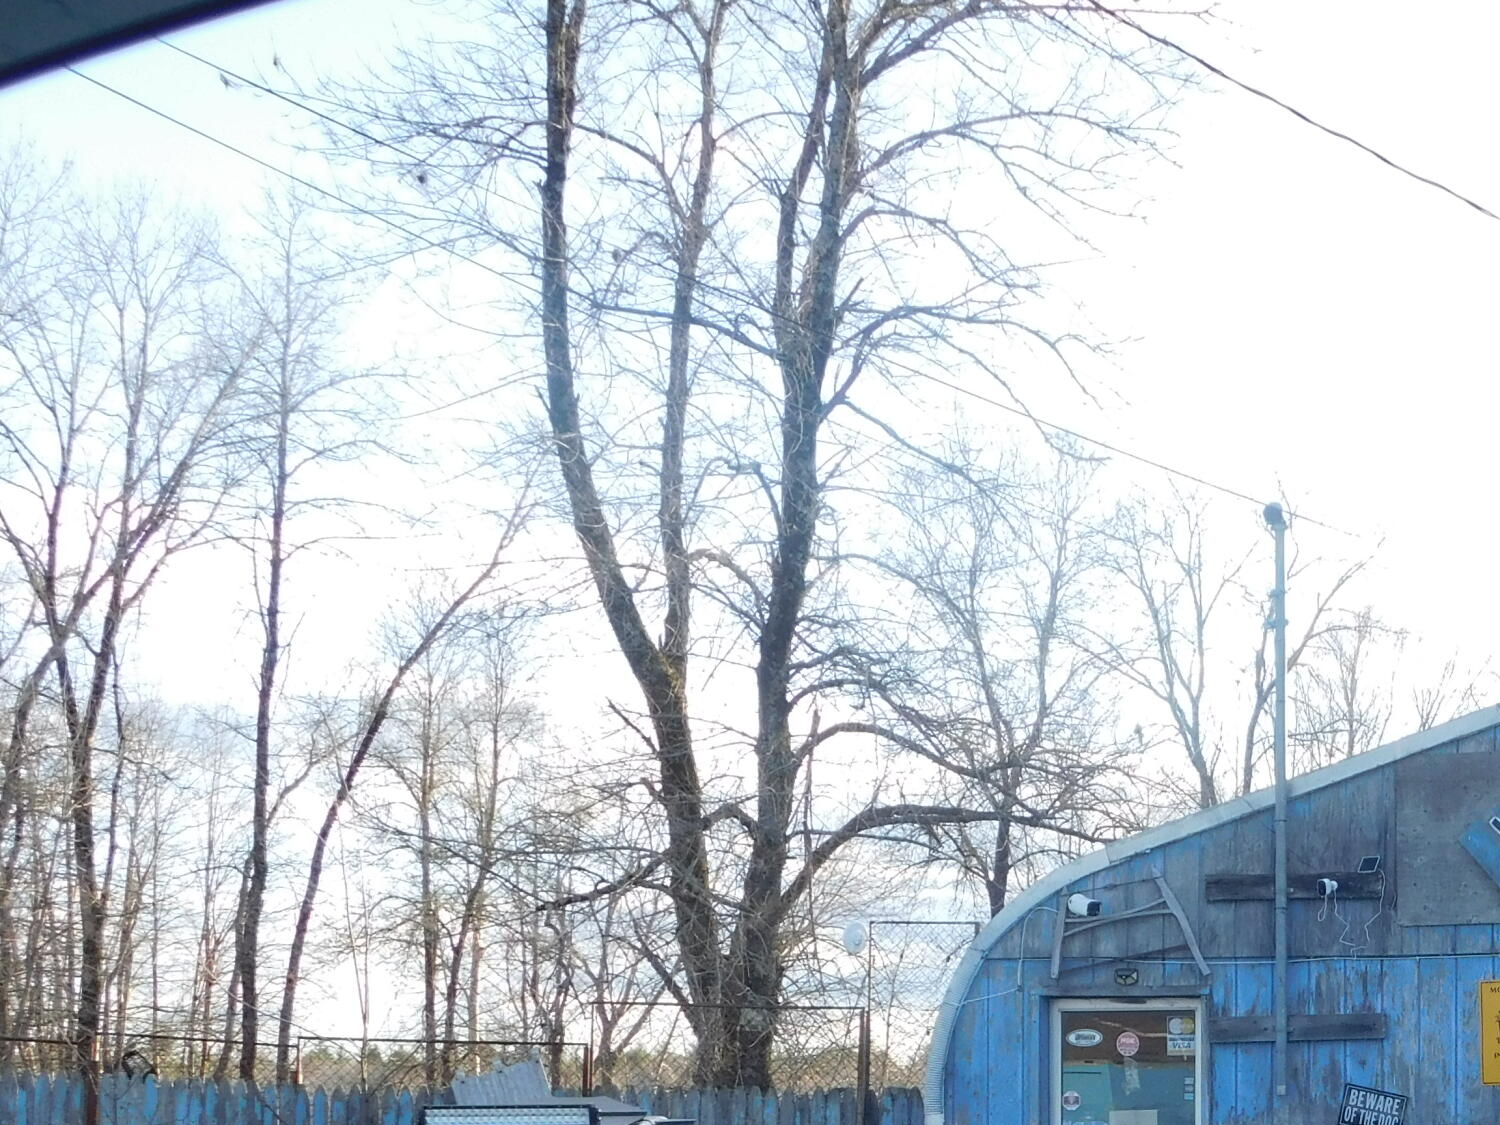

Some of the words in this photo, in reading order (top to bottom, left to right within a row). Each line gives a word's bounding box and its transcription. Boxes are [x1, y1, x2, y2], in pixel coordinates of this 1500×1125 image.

[1171, 1041, 1192, 1050] VISA
[1349, 1088, 1401, 1115] BEWARE
[1344, 1106, 1358, 1123] OF
[1359, 1109, 1378, 1125] THE
